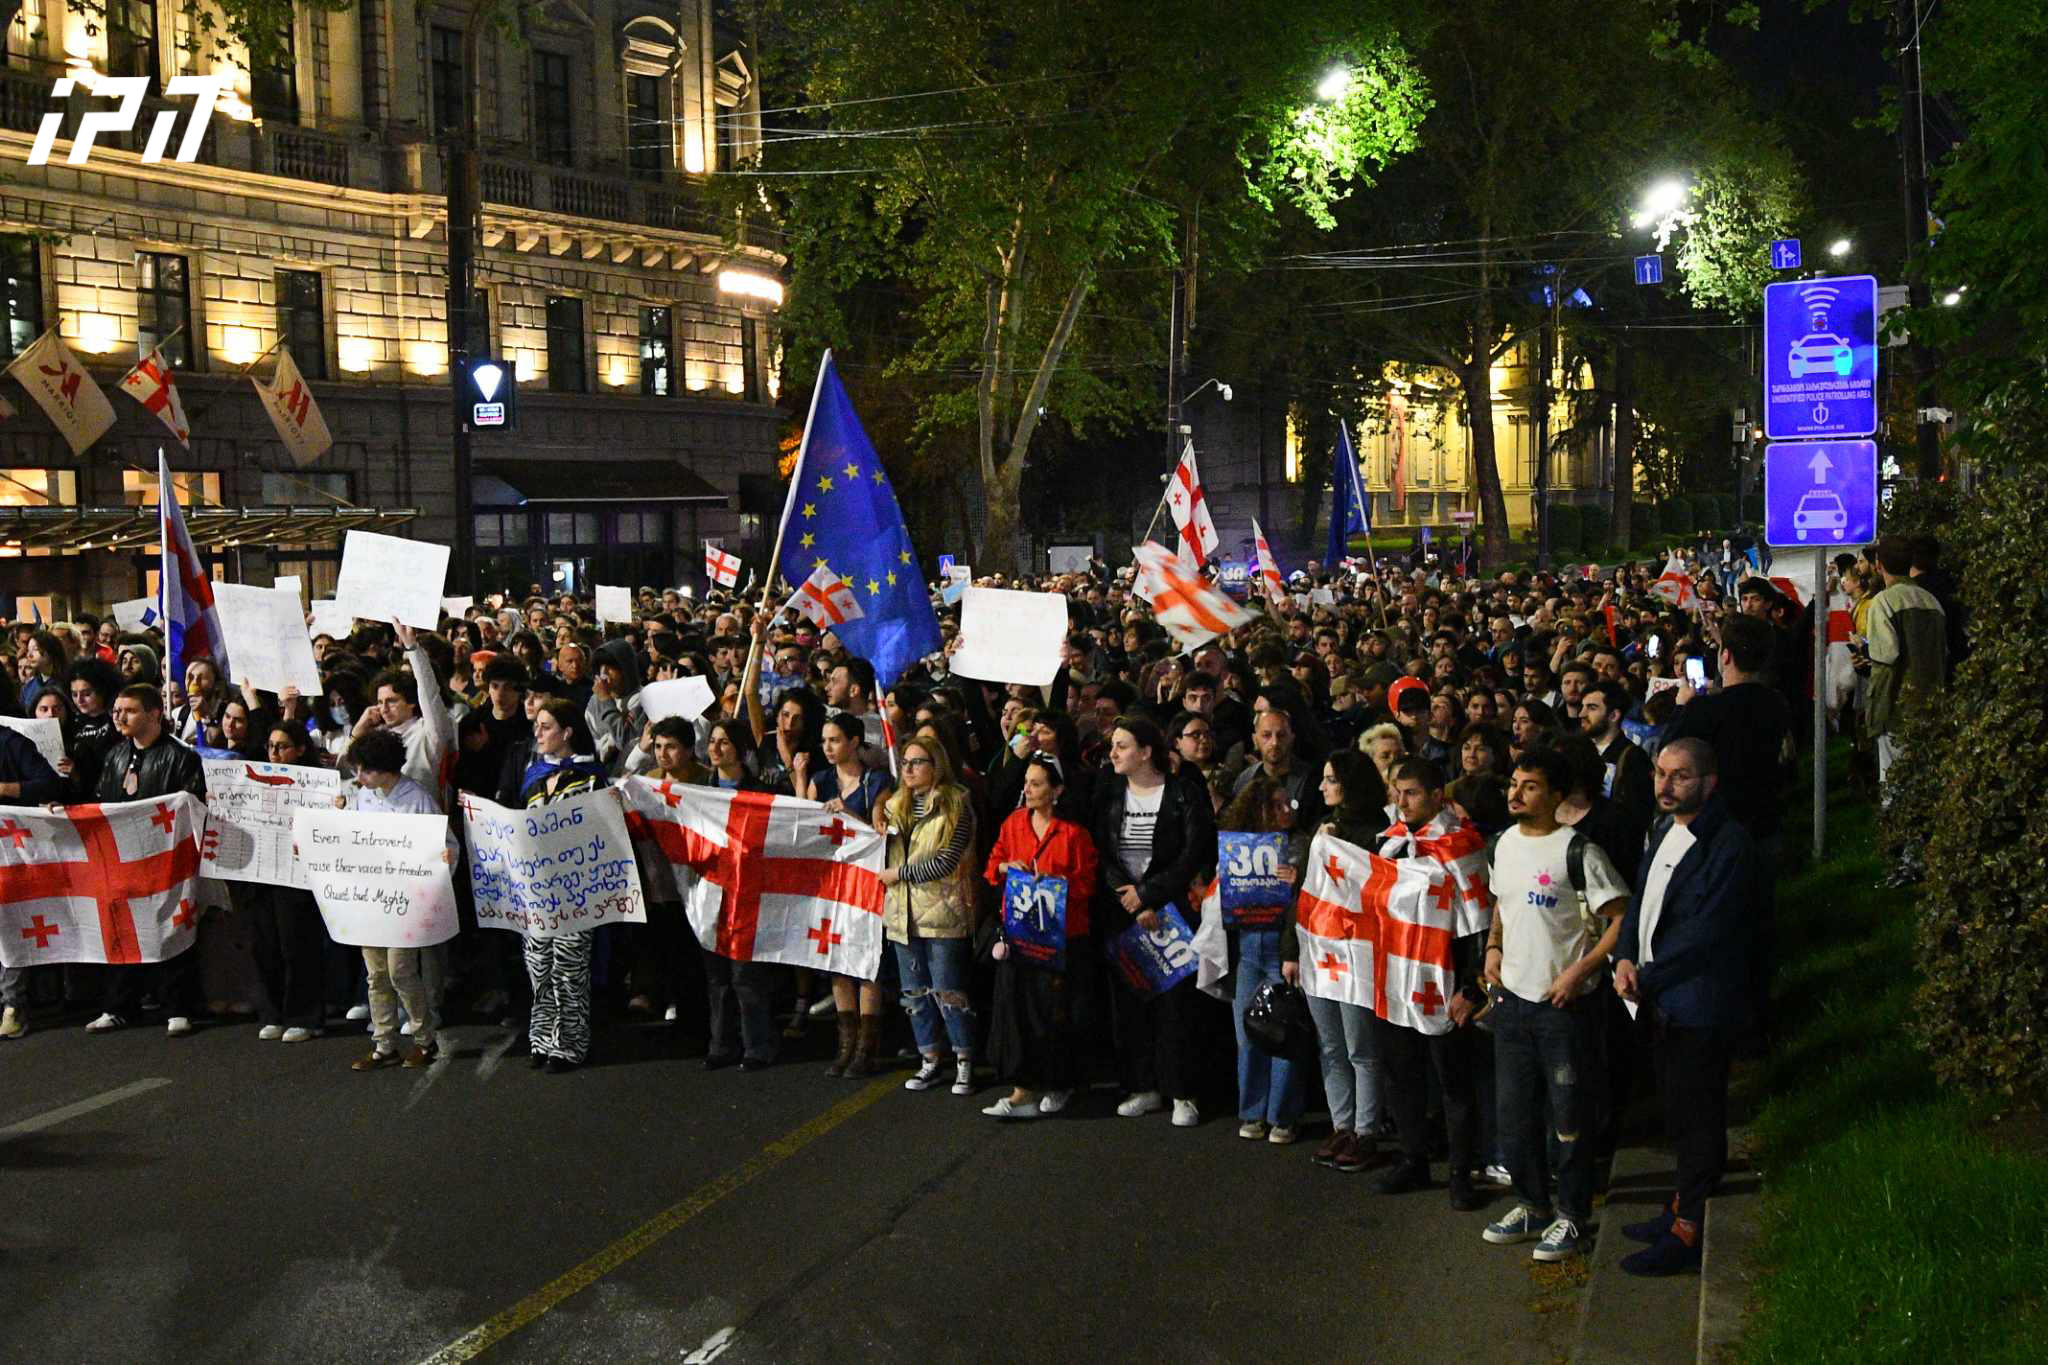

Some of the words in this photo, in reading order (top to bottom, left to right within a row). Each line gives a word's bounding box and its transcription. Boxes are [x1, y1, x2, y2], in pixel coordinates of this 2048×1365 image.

[312, 829, 341, 844] Even
[352, 830, 413, 849] Introverts
[308, 861, 331, 873] raise
[399, 861, 433, 877] freedom
[1229, 844, 1278, 877] კი
[371, 887, 410, 916] Mighty
